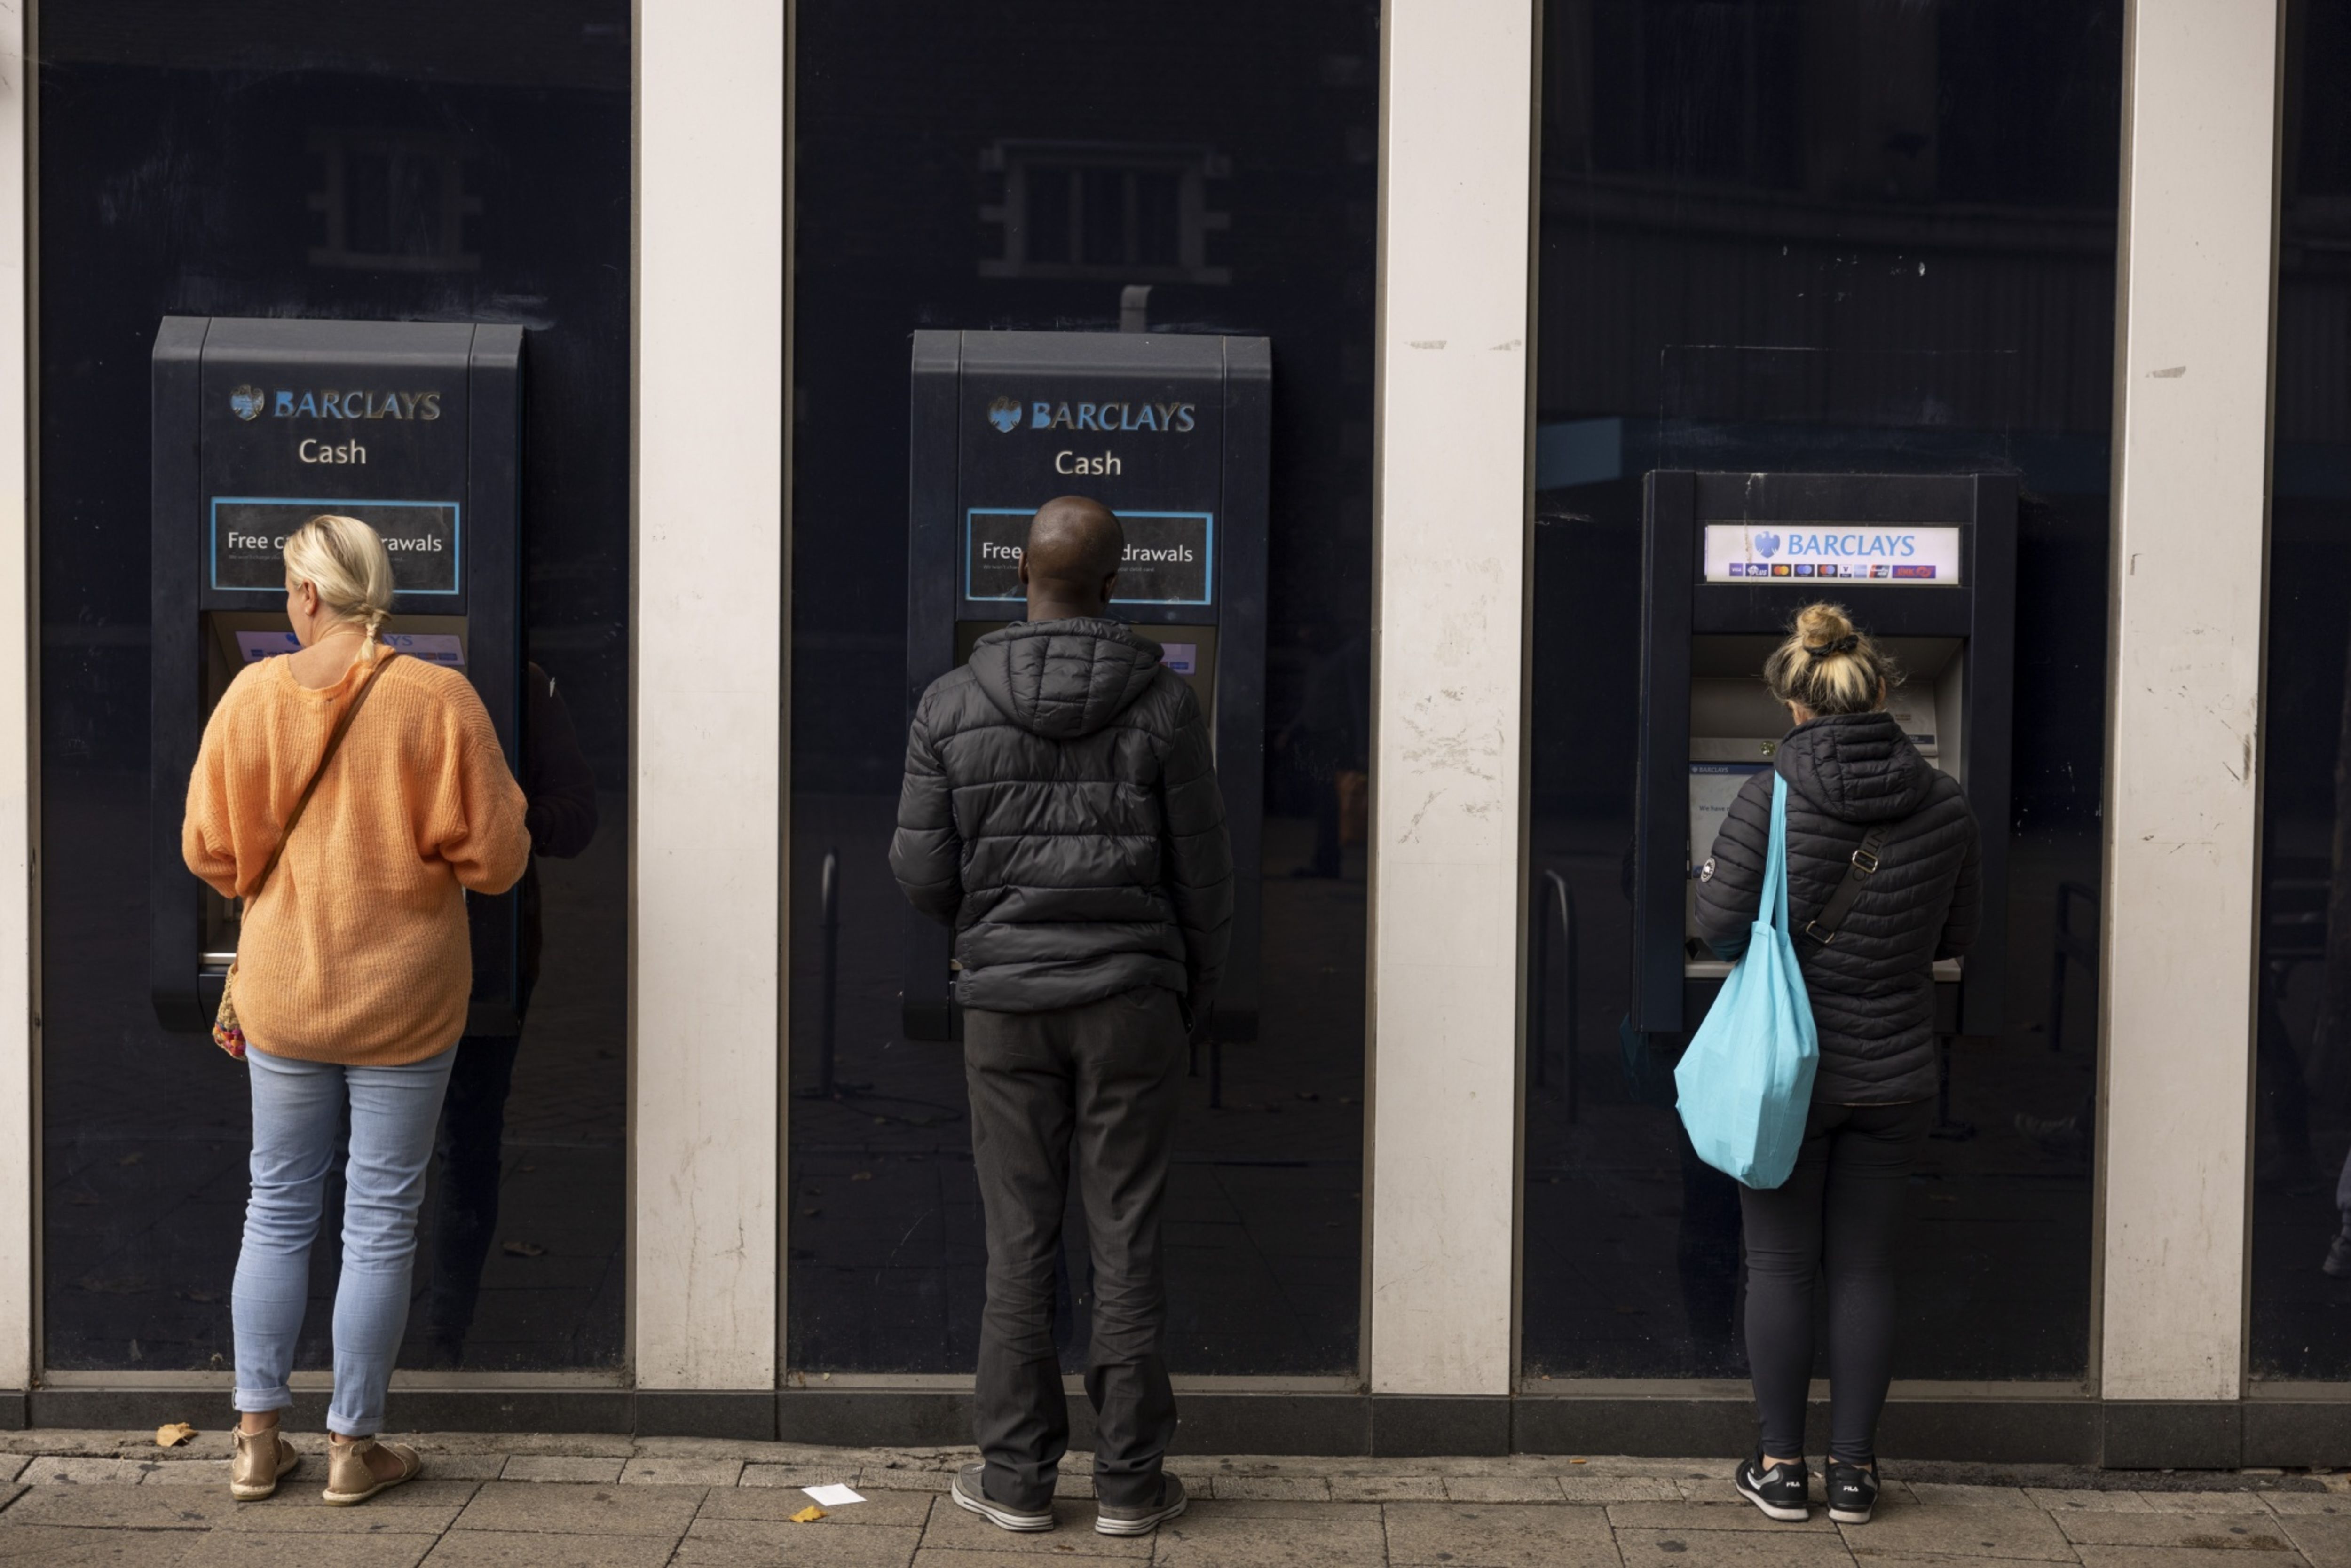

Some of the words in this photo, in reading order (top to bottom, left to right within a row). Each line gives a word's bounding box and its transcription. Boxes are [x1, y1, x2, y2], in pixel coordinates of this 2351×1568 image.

[273, 390, 441, 420] BARCLAYS
[1030, 402, 1195, 432] BARCLAYS
[299, 438, 366, 464] Cash
[1055, 450, 1121, 475] Cash
[229, 532, 268, 549] Free
[983, 542, 1022, 559] Free
[1788, 534, 1915, 556] BARCLAYS
